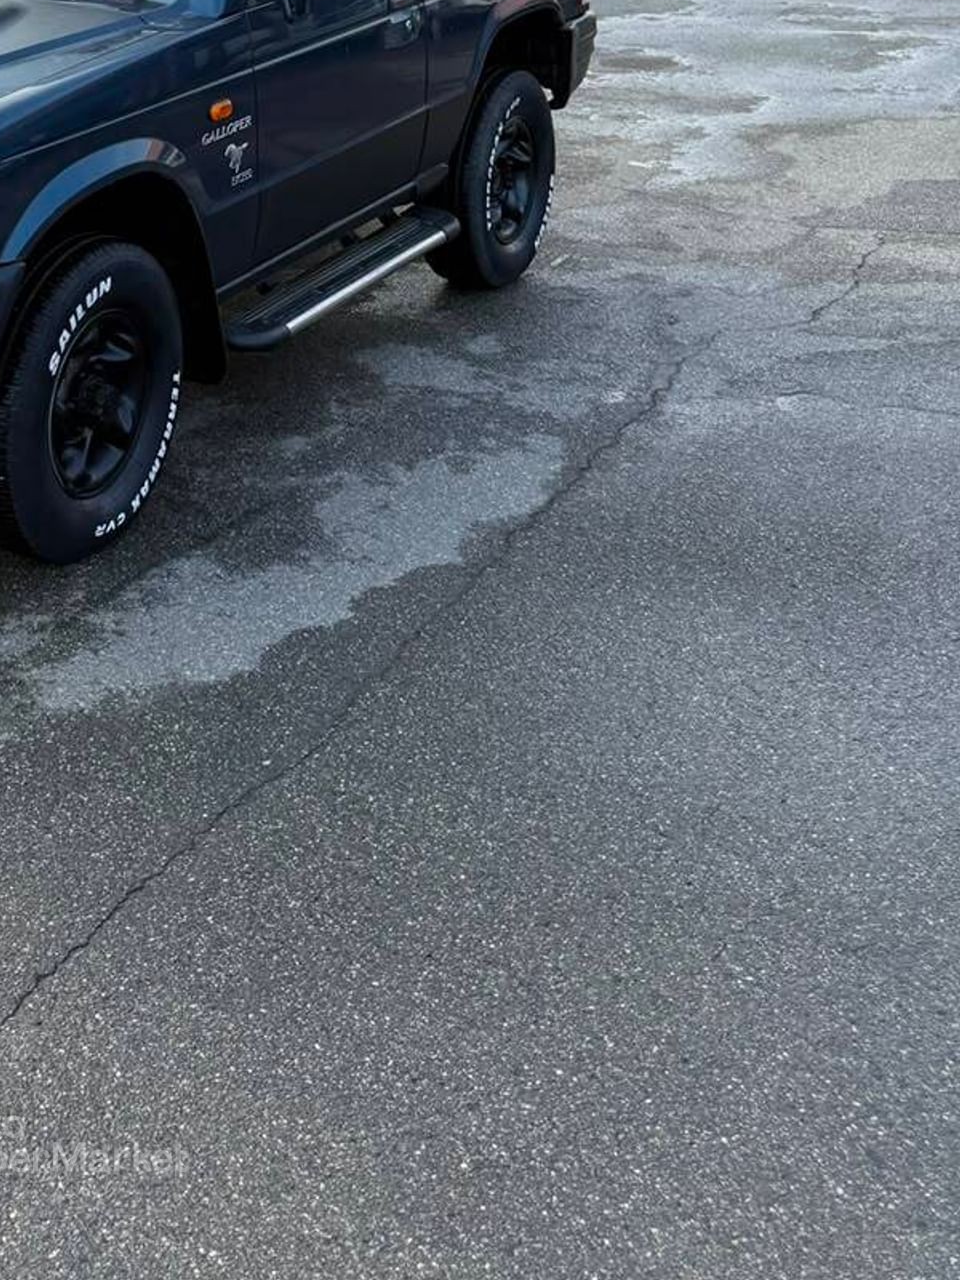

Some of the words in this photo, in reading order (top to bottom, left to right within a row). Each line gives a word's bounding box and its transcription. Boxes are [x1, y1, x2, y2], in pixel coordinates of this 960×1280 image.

[48, 276, 113, 377] SAILUN
[130, 370, 182, 513] TERRAMAX
[94, 512, 127, 538] CVR
